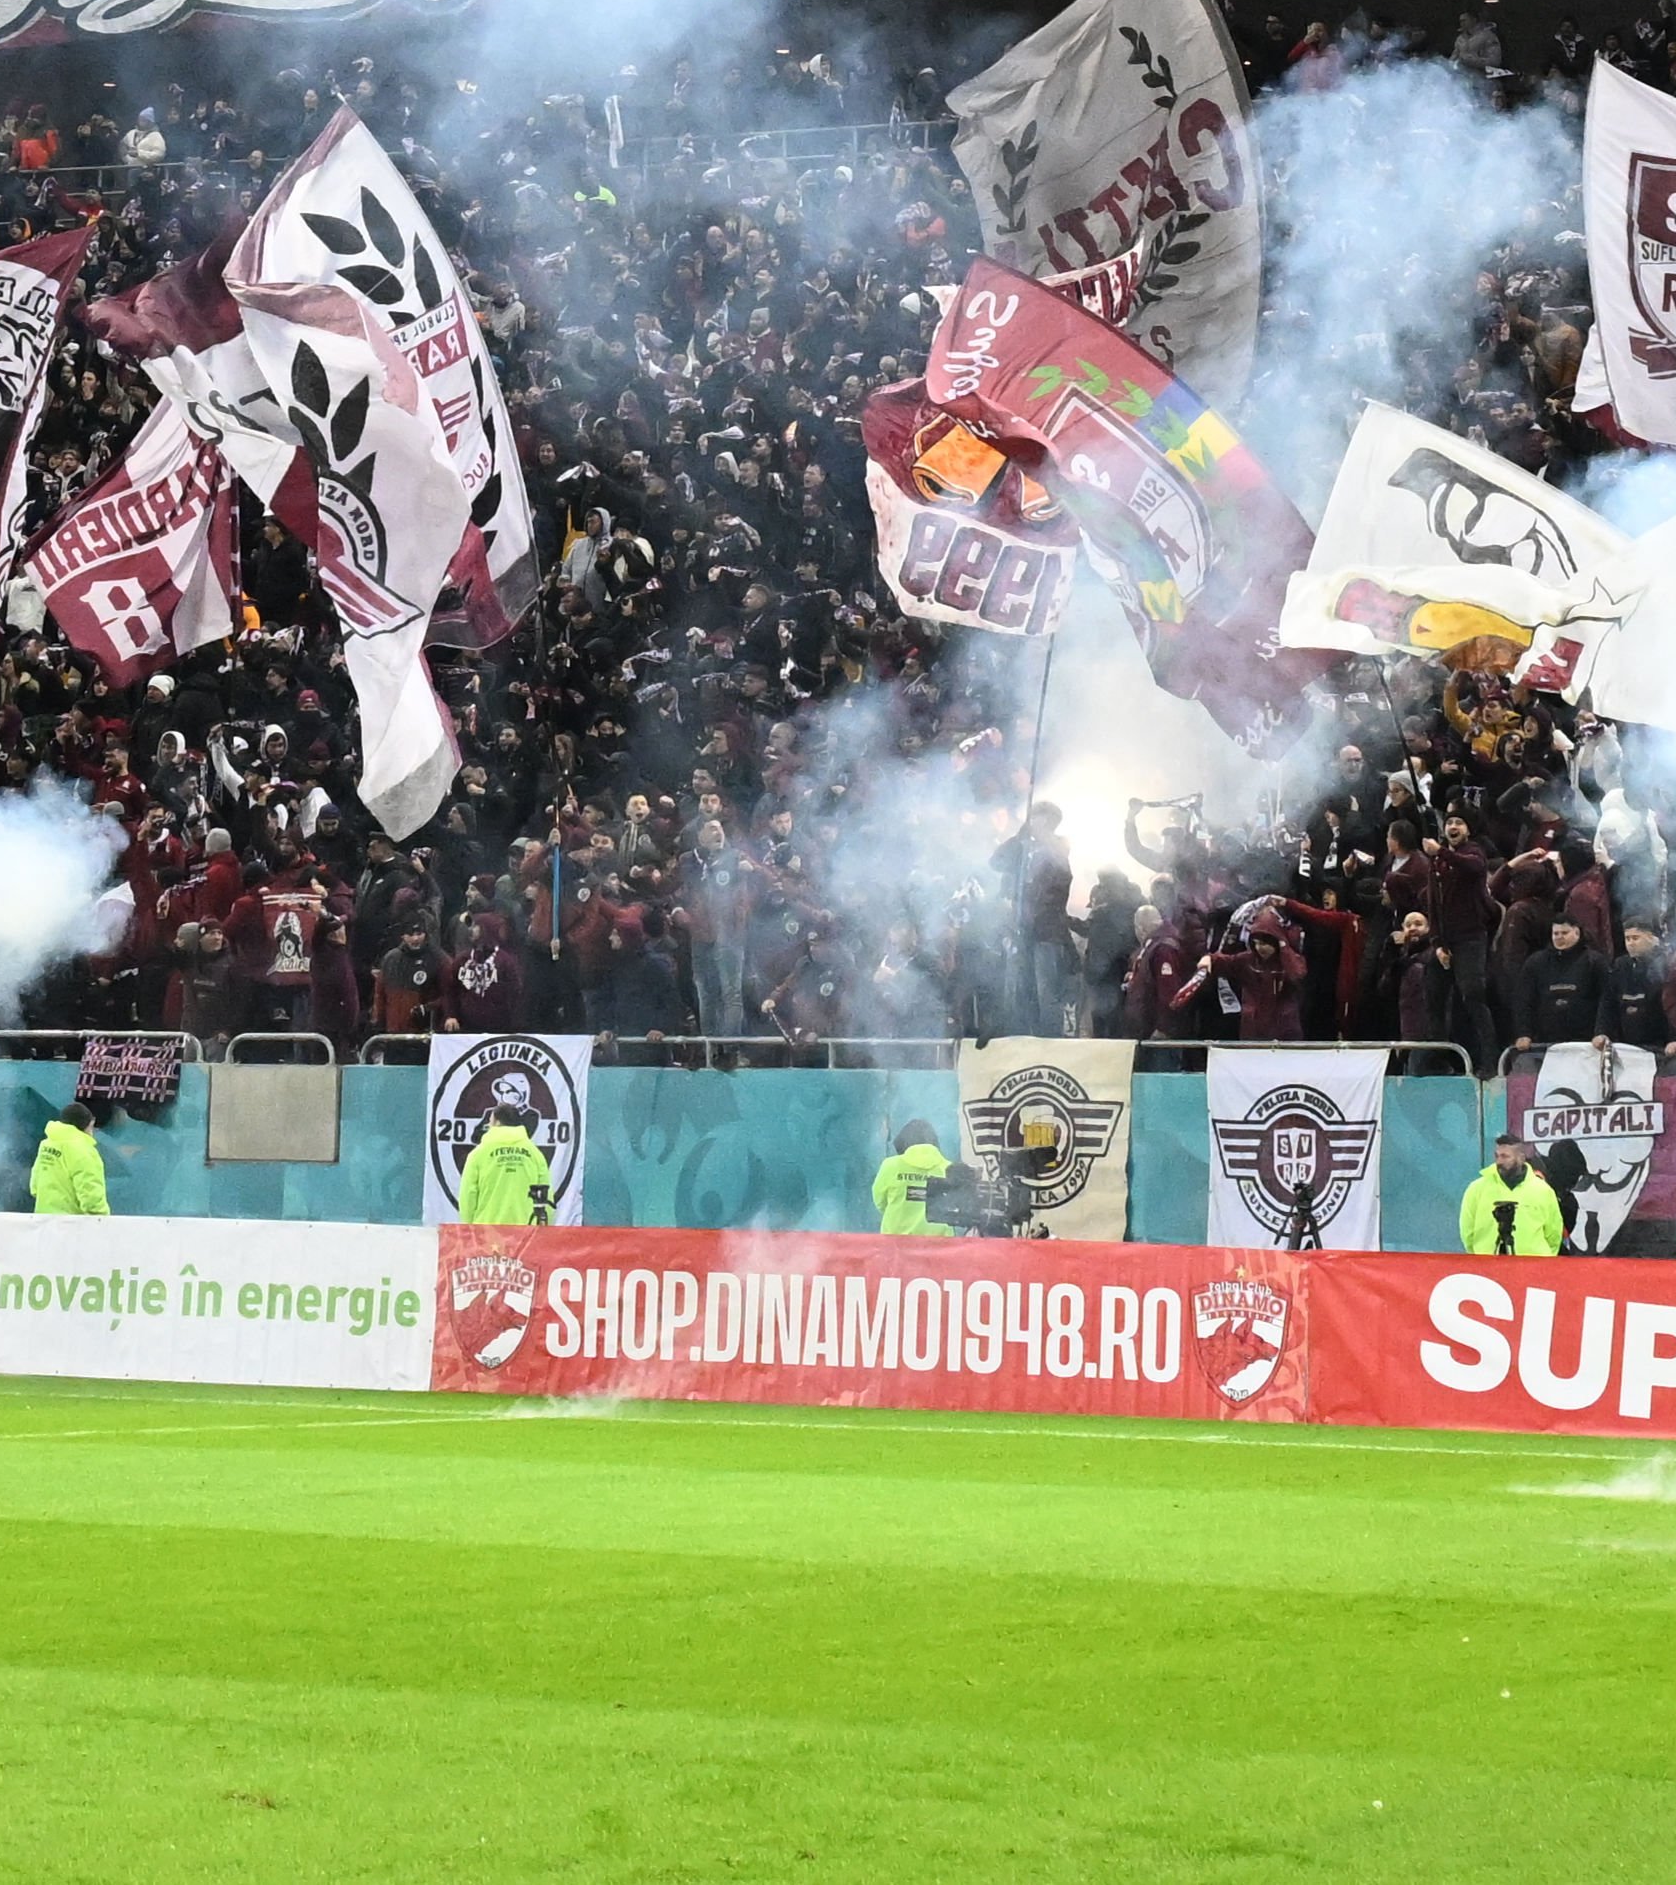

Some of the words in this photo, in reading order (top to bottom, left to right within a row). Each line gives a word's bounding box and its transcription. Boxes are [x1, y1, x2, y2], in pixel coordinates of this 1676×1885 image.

[347, 506, 377, 563] NORD
[465, 1043, 553, 1076] LEGIUNEA
[999, 1070, 1044, 1097] PELUZA
[1046, 1070, 1080, 1099] NORD
[1255, 1090, 1301, 1119] PELUZA
[1303, 1091, 1336, 1118] NORD
[437, 1118, 466, 1142] 20
[547, 1121, 570, 1144] 10
[1532, 1105, 1655, 1139] CAPITALI
[1279, 1136, 1290, 1154] S
[1300, 1135, 1311, 1154] V
[1242, 1183, 1284, 1227] SUFLE
[455, 1265, 534, 1288] DINAMO
[180, 1263, 223, 1317] în
[237, 1274, 421, 1337] energie
[1197, 1295, 1284, 1317] DINAMO
[545, 1267, 1182, 1383] SHOP.DINAMO1948.RO
